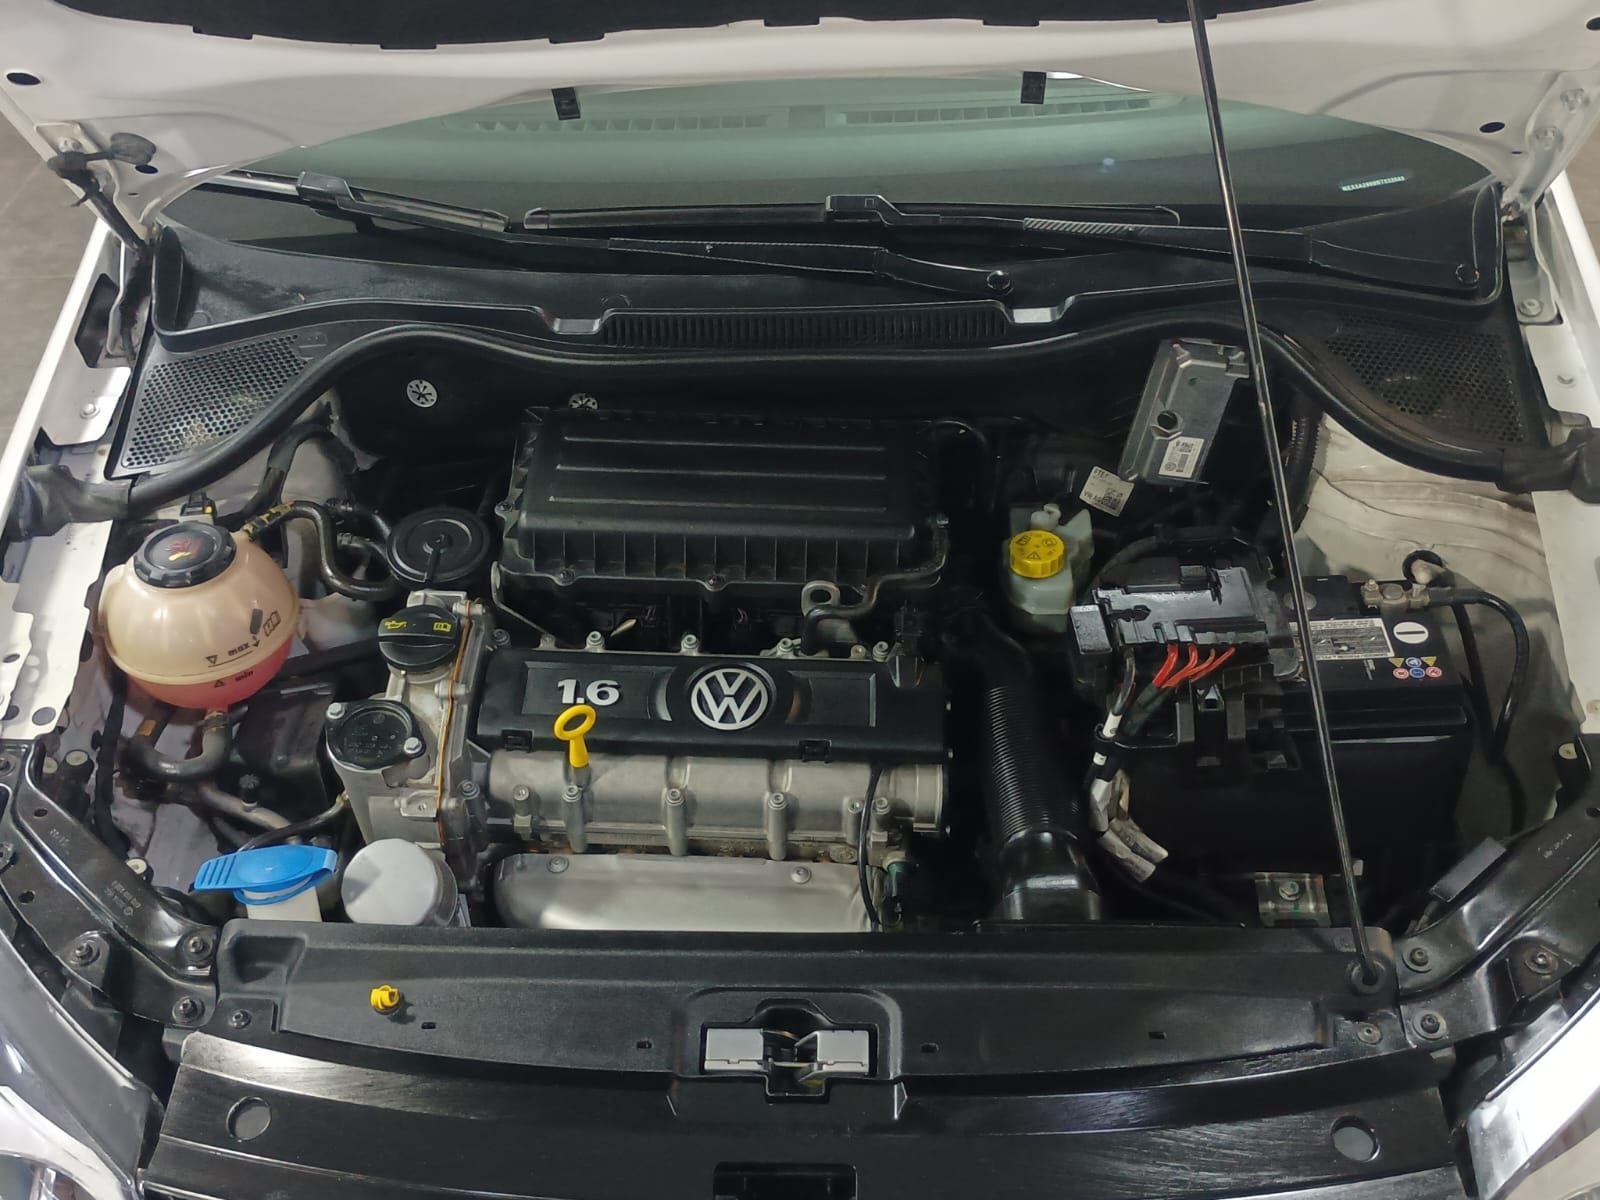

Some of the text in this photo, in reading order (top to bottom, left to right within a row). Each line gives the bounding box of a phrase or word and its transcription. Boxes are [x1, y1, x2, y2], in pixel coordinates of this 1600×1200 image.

[228, 642, 250, 656] max
[235, 671, 253, 681] min
[557, 679, 620, 706] 1.6
[699, 670, 763, 724] VW
